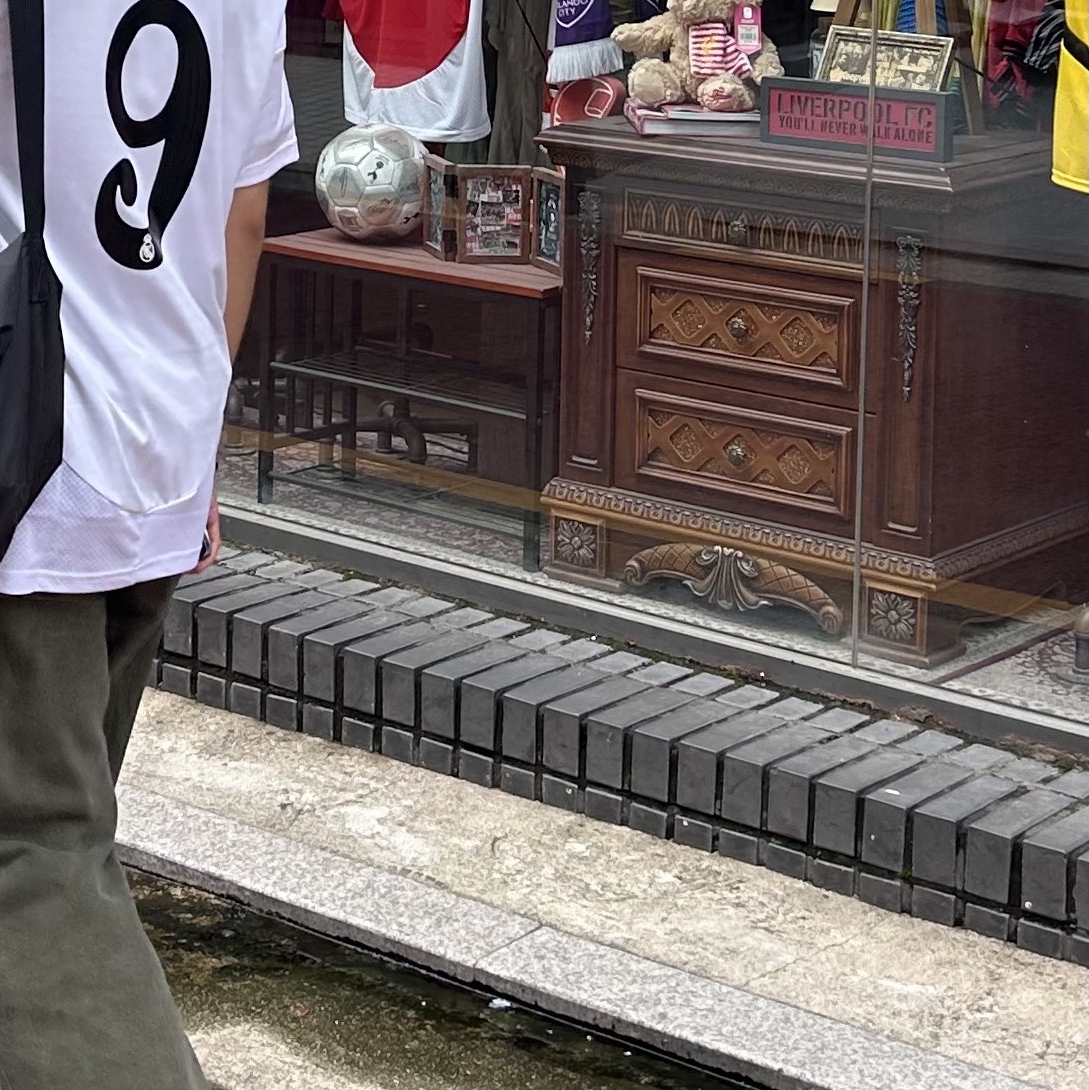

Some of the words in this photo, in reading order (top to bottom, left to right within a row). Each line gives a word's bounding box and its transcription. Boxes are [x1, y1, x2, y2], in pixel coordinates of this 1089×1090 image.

[777, 93, 898, 126] LIVERPOOL
[905, 105, 932, 128] FC
[820, 120, 857, 136] NEVER
[893, 127, 933, 144] ALONE
